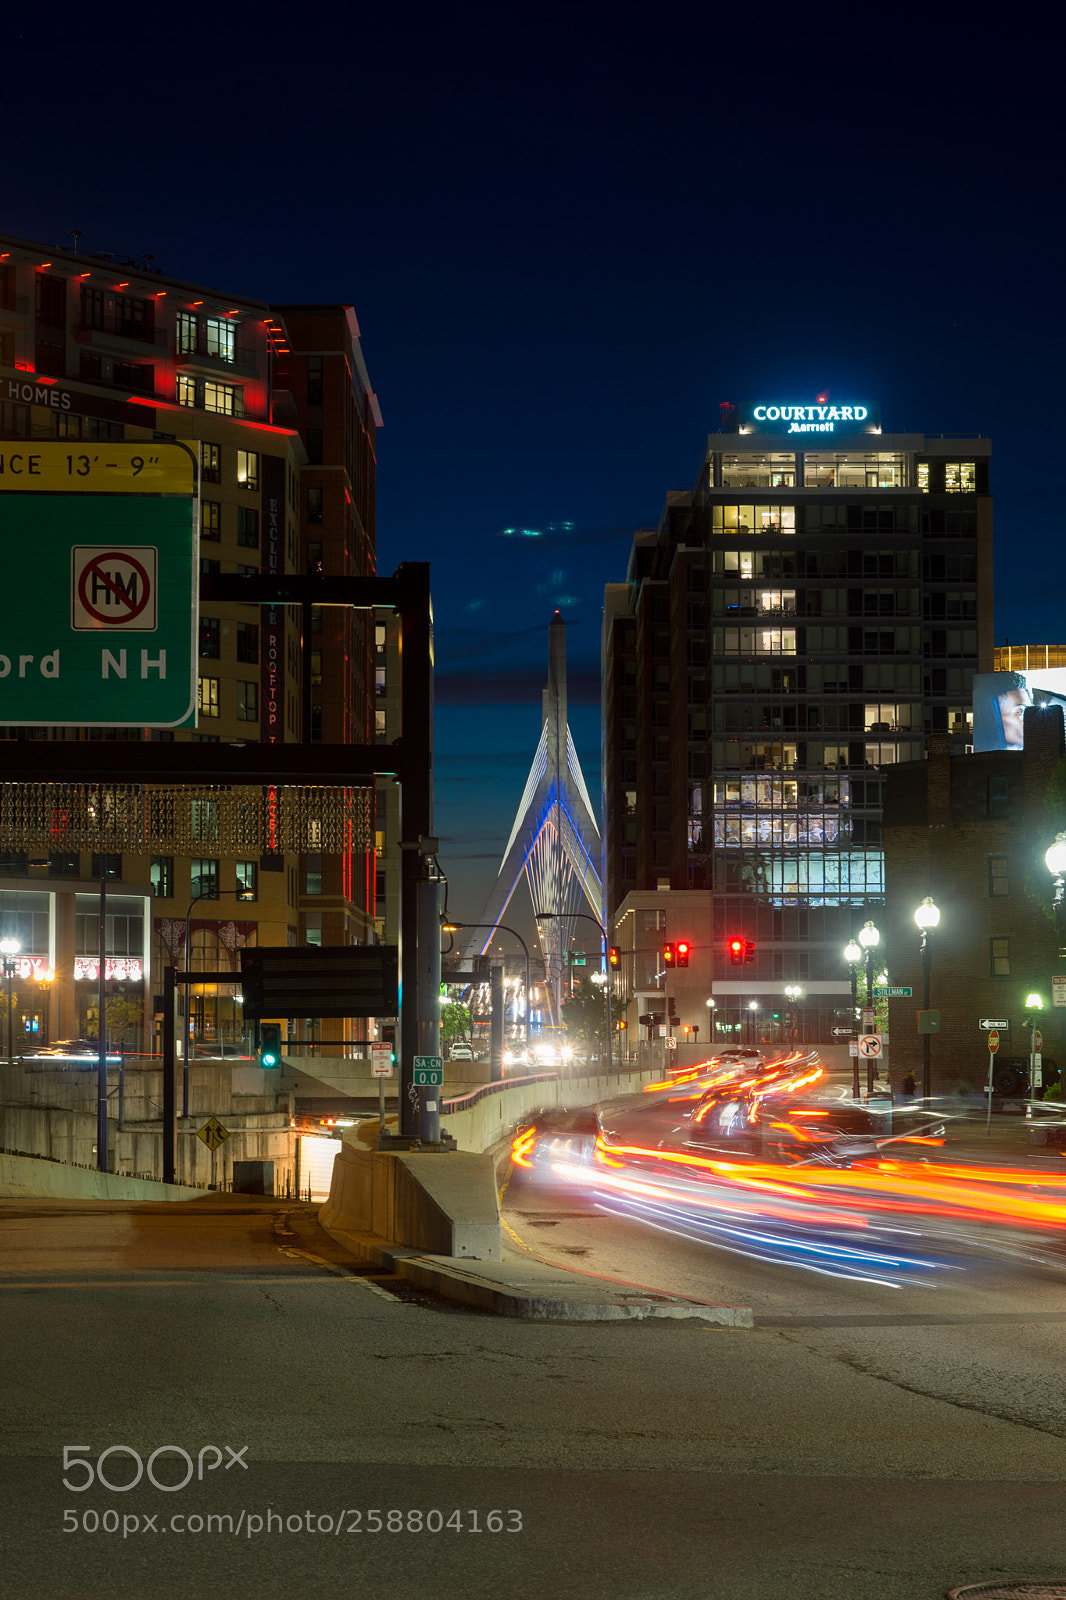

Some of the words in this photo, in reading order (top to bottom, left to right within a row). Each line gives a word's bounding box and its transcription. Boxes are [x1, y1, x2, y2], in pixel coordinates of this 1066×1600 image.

[8, 381, 71, 410] HOMES
[753, 406, 868, 421] COURTYARD
[788, 422, 834, 434] Marriott
[0, 454, 41, 475] CE
[91, 571, 138, 605] HM
[268, 635, 277, 725] ROOFTOP
[877, 988, 904, 996] STILLMAN
[988, 1037, 999, 1047] STOP
[419, 1072, 438, 1084] 0.0
